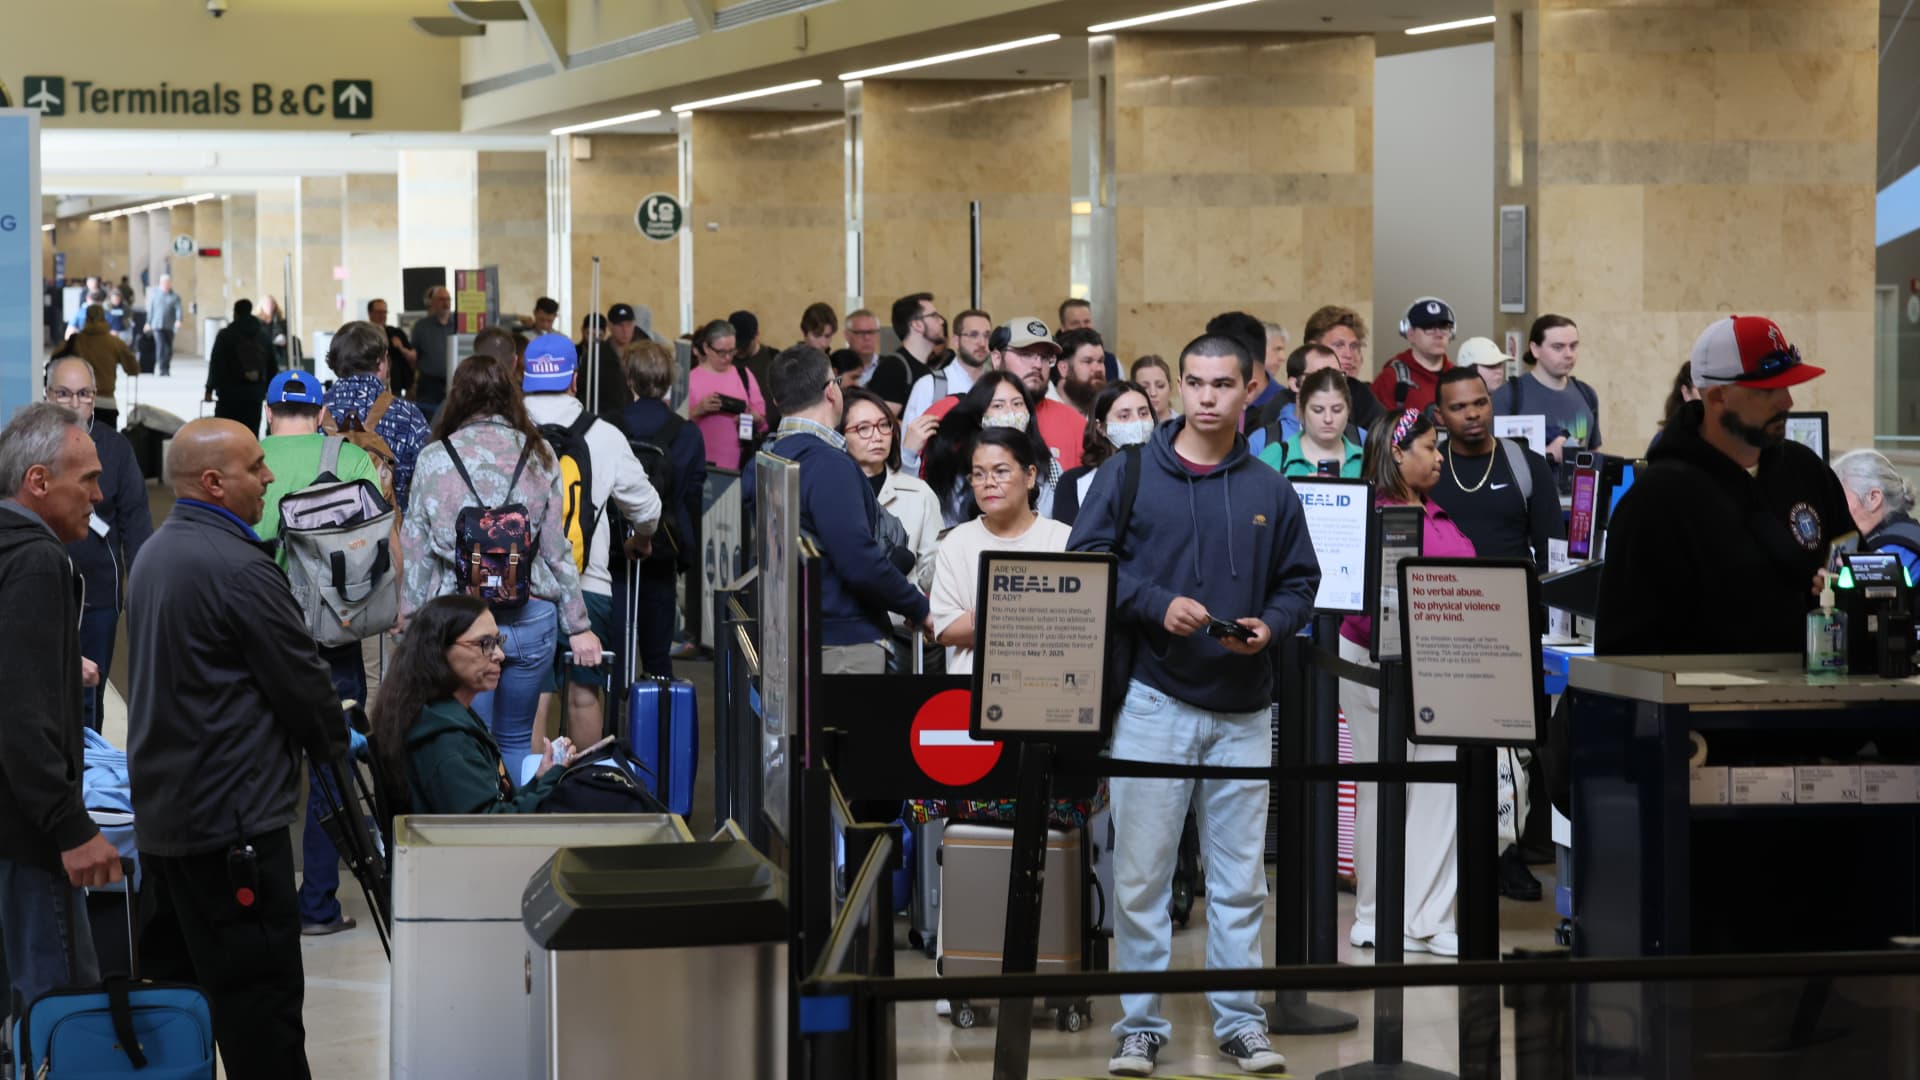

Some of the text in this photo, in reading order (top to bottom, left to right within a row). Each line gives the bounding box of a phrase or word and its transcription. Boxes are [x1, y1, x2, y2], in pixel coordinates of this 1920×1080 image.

[72, 81, 241, 115] Terminals
[1336, 495, 1351, 507] ID
[994, 566, 1027, 574] ARE YOU
[1412, 573, 1459, 582] No threats.
[993, 575, 1081, 593] REAL ID
[1413, 587, 1484, 597] No verbal abuse.
[1414, 601, 1501, 611] No physical violence
[1414, 612, 1464, 622] of any kind.
[1780, 793, 1791, 801] XL
[1840, 790, 1859, 800] XXL
